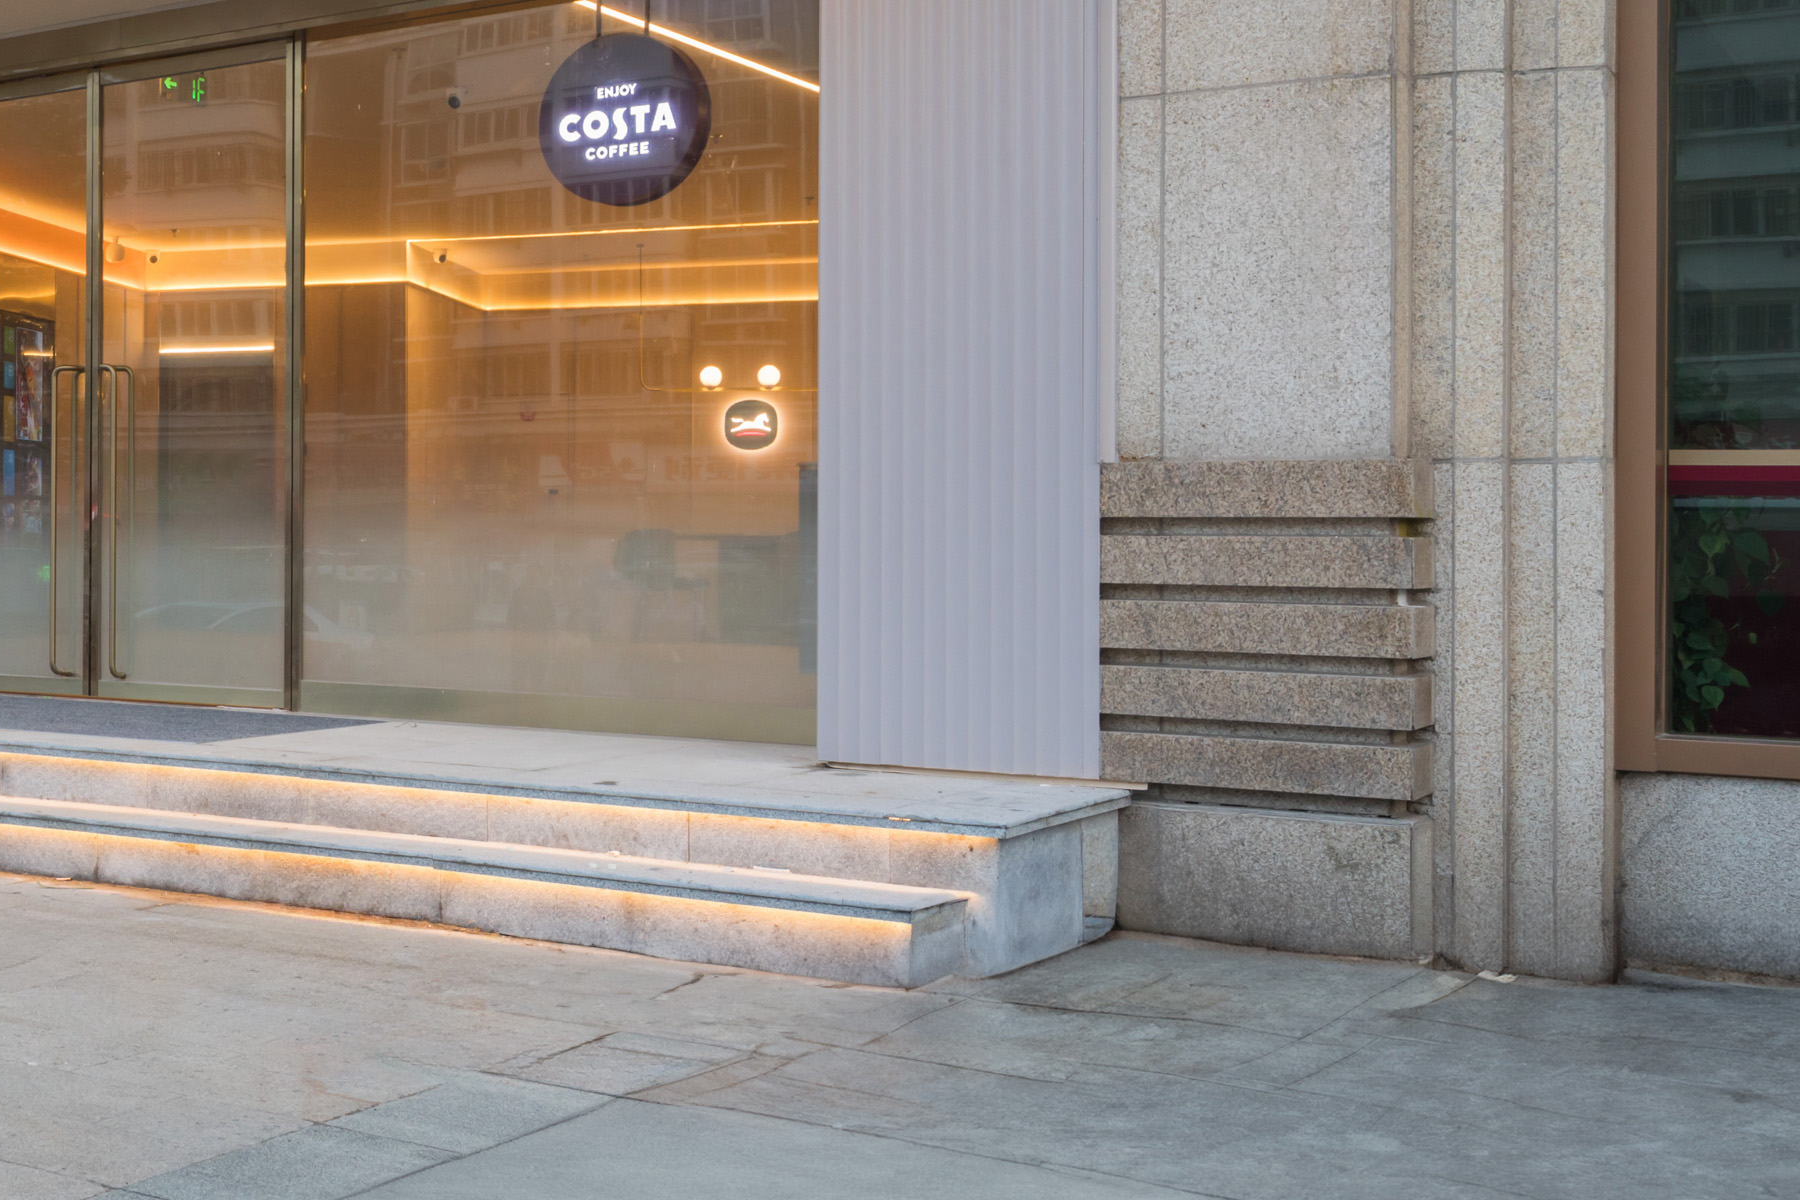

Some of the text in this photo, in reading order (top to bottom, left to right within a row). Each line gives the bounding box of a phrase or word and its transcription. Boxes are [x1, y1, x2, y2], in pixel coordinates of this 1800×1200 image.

[596, 83, 637, 100] ENJOY
[559, 102, 677, 142] COSTA
[585, 141, 650, 160] COFFEE
